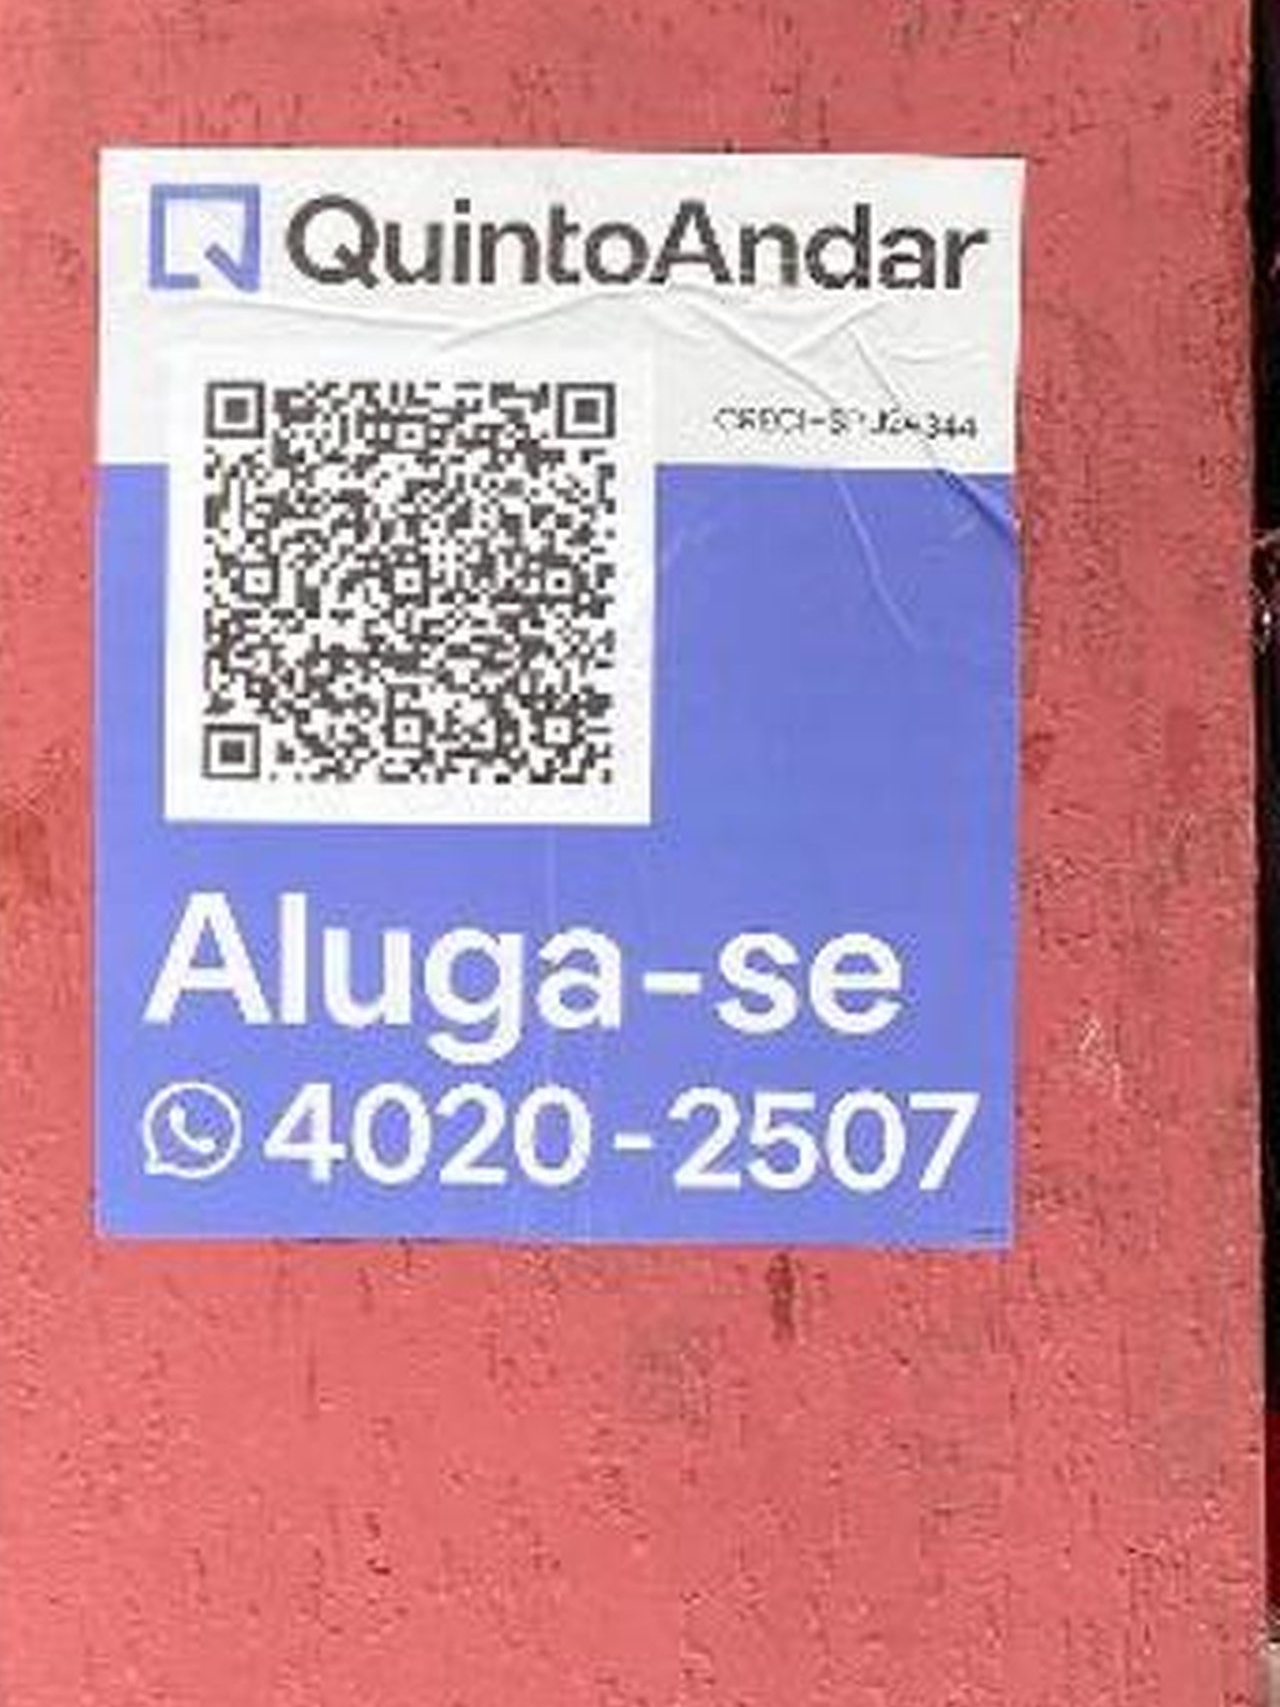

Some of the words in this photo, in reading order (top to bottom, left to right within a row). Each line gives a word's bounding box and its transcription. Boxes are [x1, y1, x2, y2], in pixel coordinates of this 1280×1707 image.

[285, 193, 989, 291] QuintoAndar
[142, 892, 904, 1066] Aluga-se
[262, 1082, 981, 1192] 4020-2507
